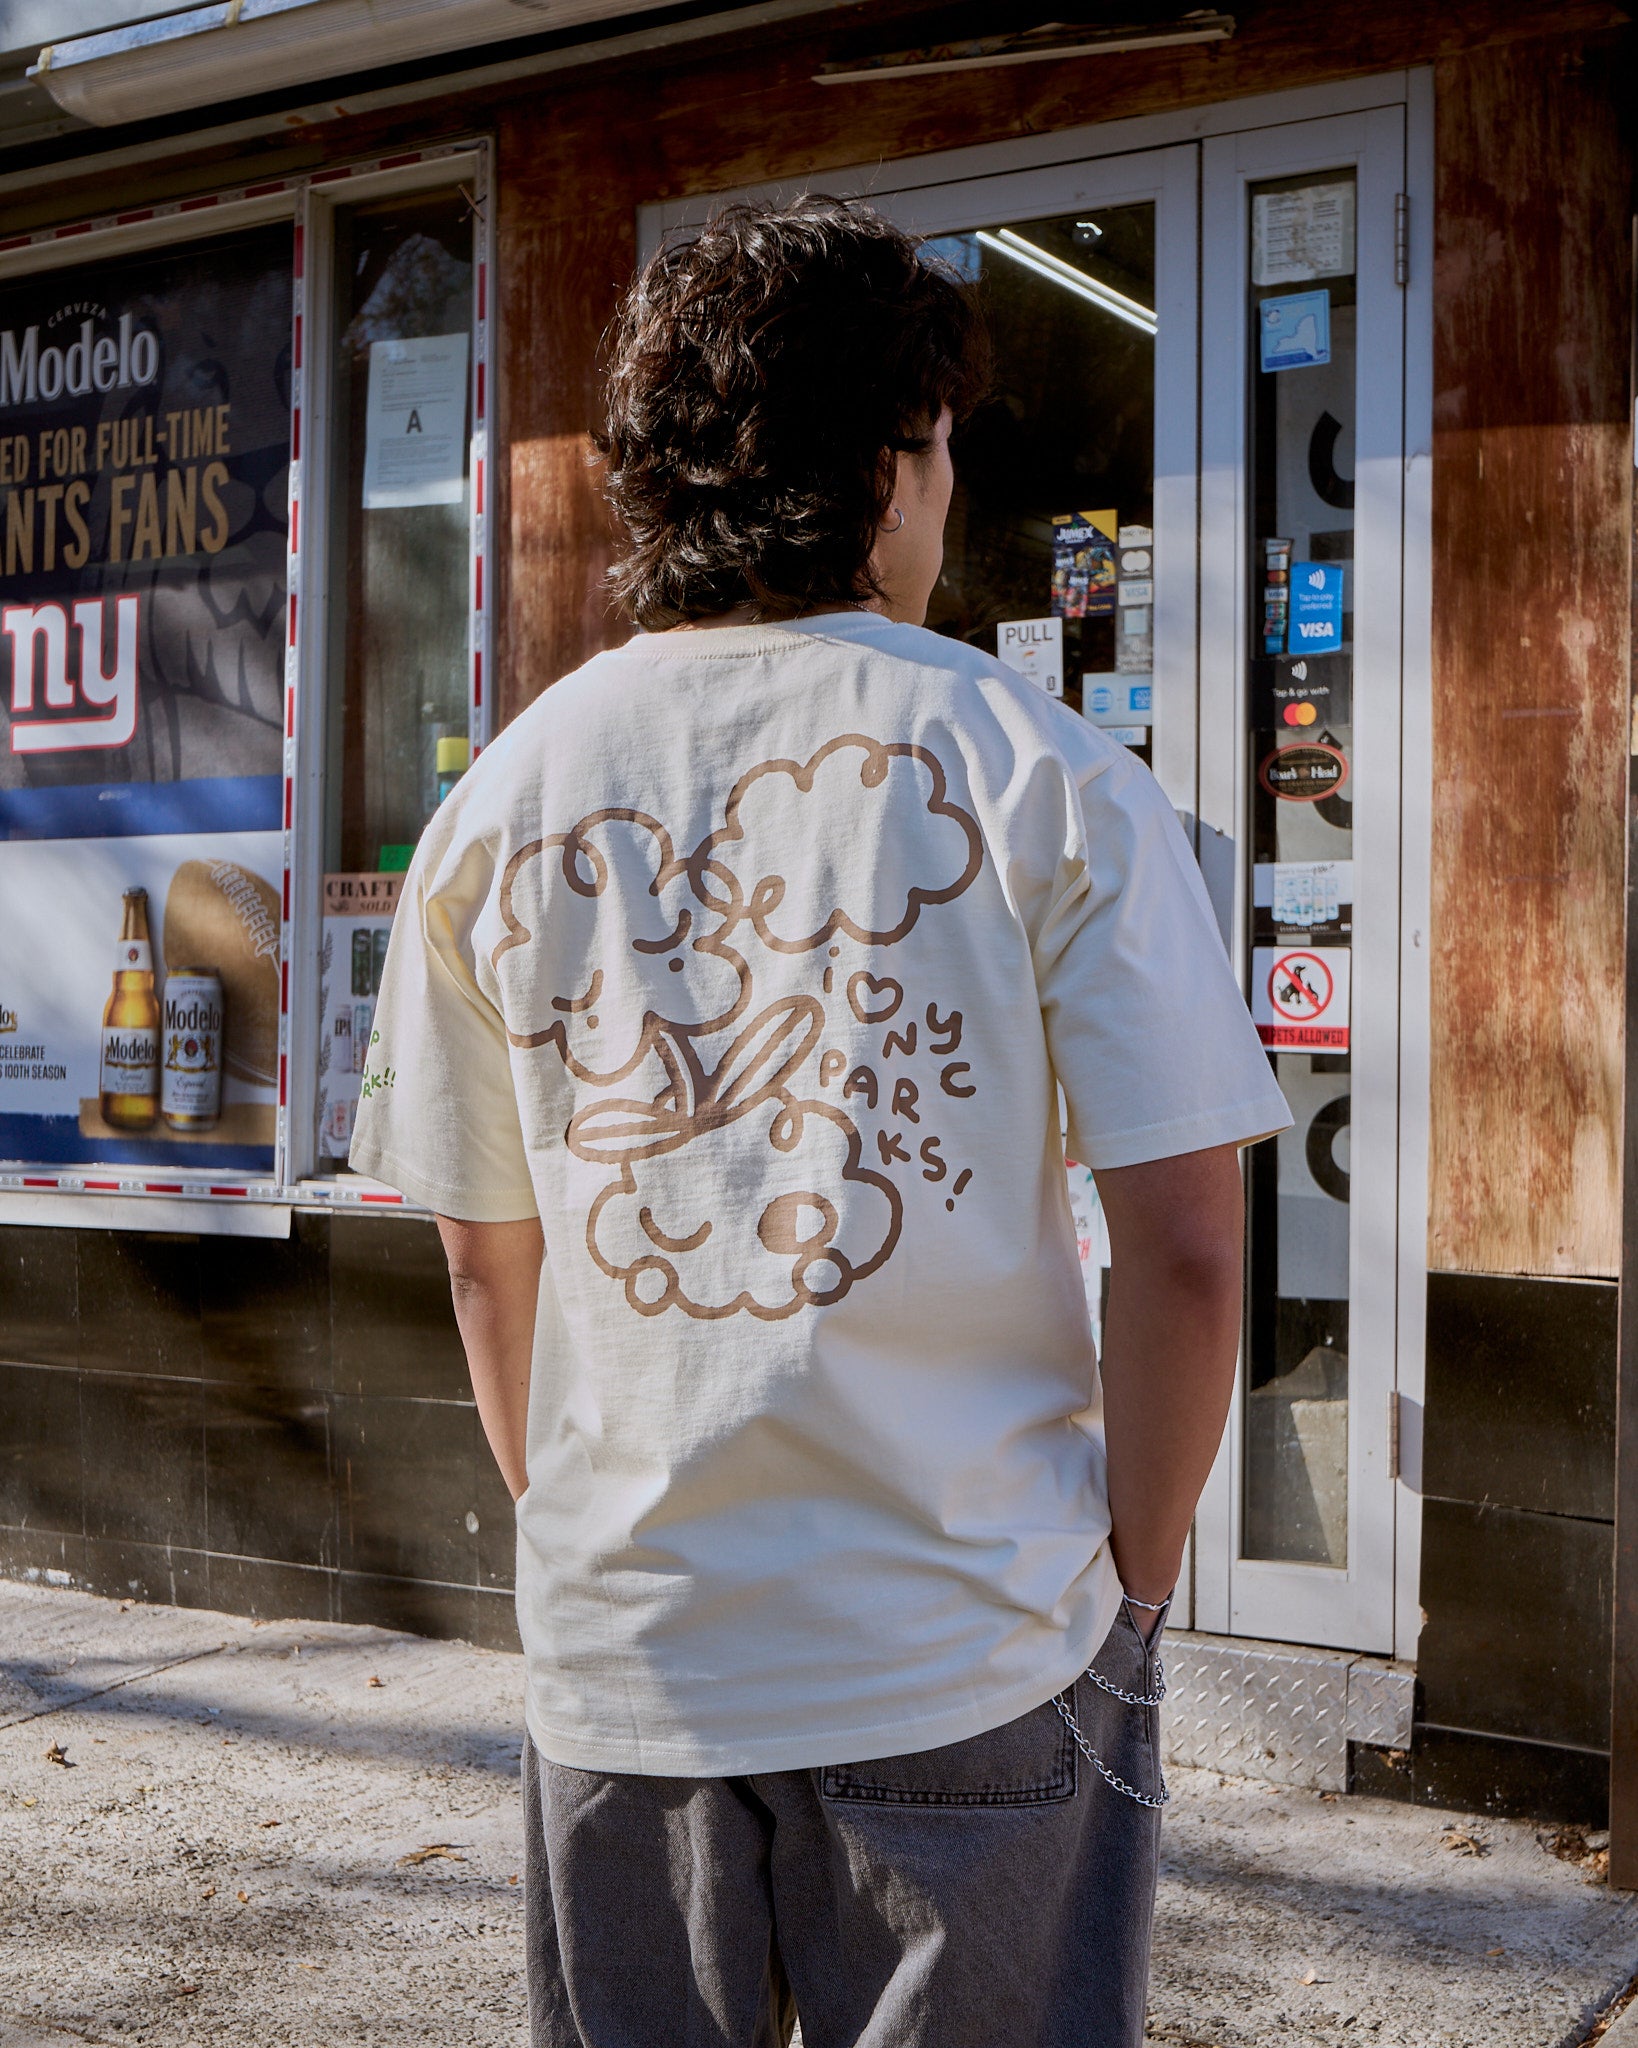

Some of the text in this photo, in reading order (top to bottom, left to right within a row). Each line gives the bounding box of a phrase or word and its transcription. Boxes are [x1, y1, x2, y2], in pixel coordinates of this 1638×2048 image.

[48, 301, 107, 328] CERVEZA
[0, 312, 159, 406] Modelo
[406, 409, 423, 434] A
[39, 425, 87, 480] FOR
[96, 404, 230, 471] FULL-TIME
[110, 461, 229, 564] FANS
[1006, 624, 1053, 645] PULL
[1298, 621, 1334, 638] VISA
[326, 881, 397, 898] CRAFT
[165, 1000, 220, 1031] Modelo
[110, 1036, 155, 1061] Modelo
[1272, 1027, 1295, 1042] PETS
[1298, 1029, 1344, 1045] ALLOWED
[0, 1044, 46, 1061] CELEBRATE
[5, 1063, 30, 1079] 100TH
[31, 1065, 67, 1080] SEASON
